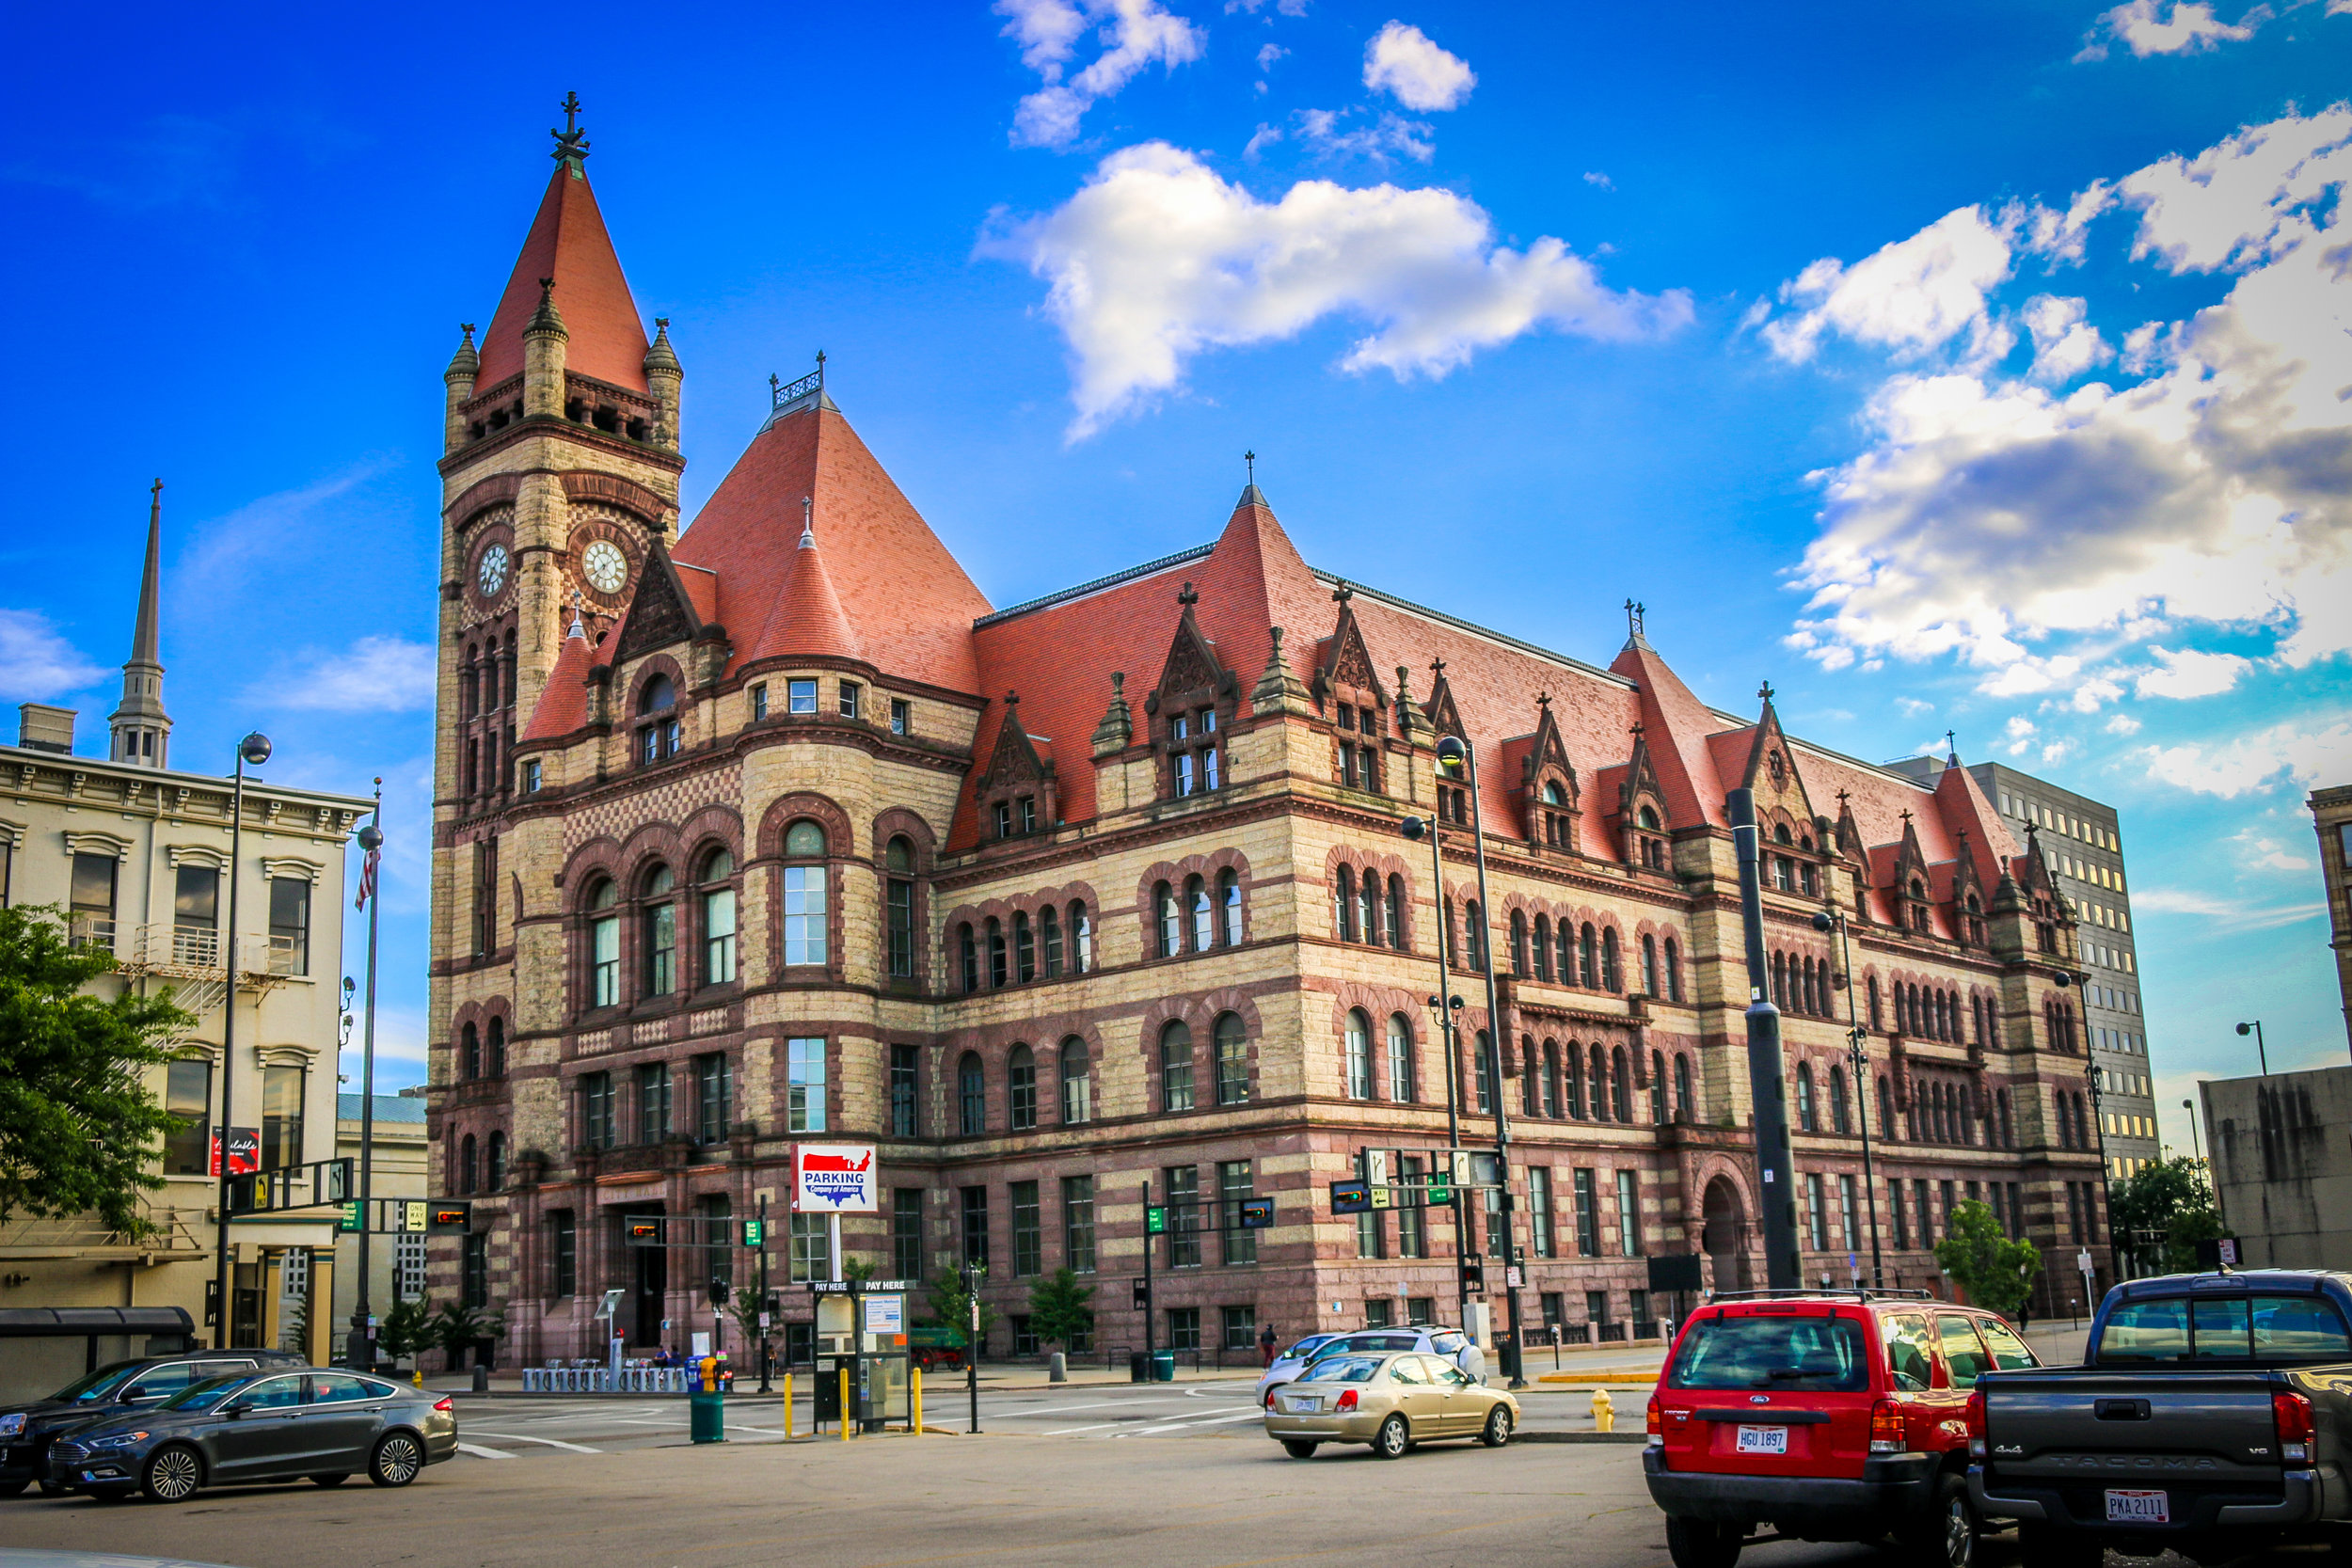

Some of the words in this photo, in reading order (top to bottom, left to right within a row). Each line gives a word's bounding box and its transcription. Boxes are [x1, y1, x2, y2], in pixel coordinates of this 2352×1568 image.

[805, 1173, 864, 1183] PARKING
[810, 1185, 832, 1194] Company
[815, 1283, 827, 1291] PAY
[829, 1282, 847, 1291] HERE
[866, 1281, 882, 1291] PAY
[882, 1280, 905, 1290] HERE
[1740, 1433, 1758, 1446] HGU
[1761, 1433, 1783, 1447] 1897
[1994, 1445, 2023, 1453] 4x4
[2049, 1455, 2217, 1469] TACOMA
[2109, 1497, 2132, 1514] PKA
[2135, 1498, 2163, 1514] 2111
